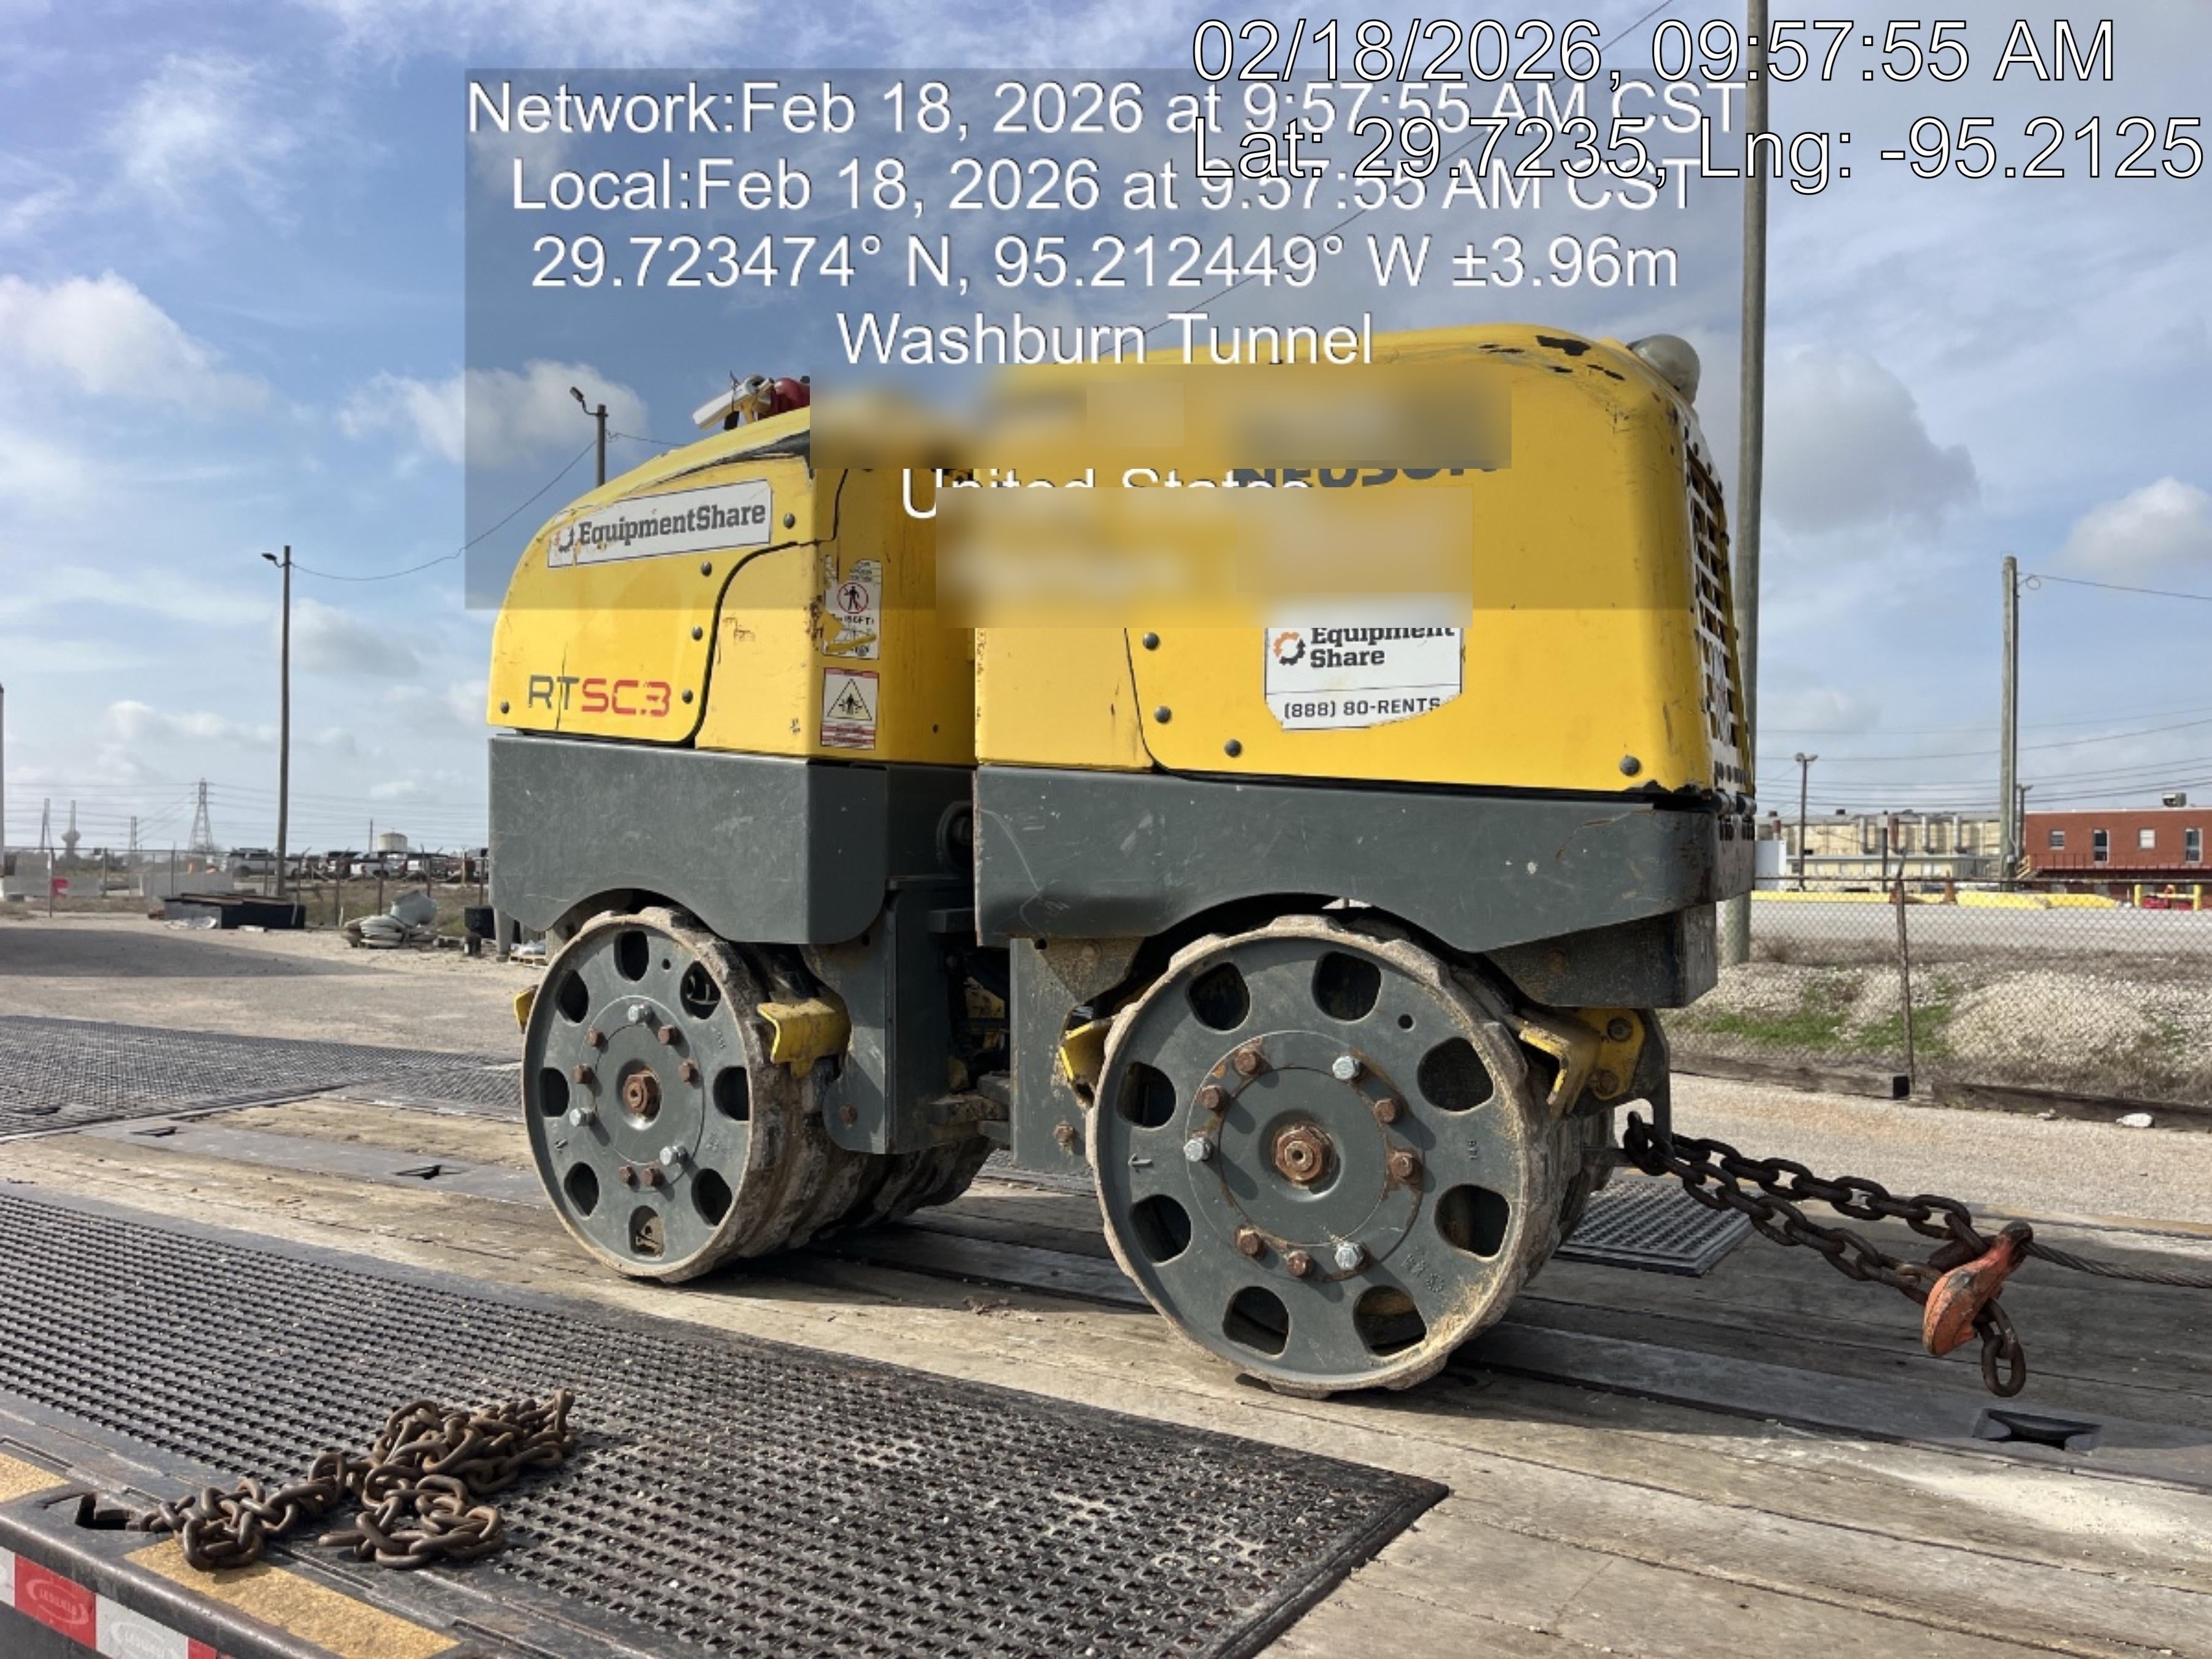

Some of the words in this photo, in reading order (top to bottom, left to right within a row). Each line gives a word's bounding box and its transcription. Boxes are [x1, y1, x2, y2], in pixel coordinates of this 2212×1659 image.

[578, 504, 766, 547] EquipmentShare
[1310, 649, 1386, 668] Share
[1284, 700, 1336, 719] (888)
